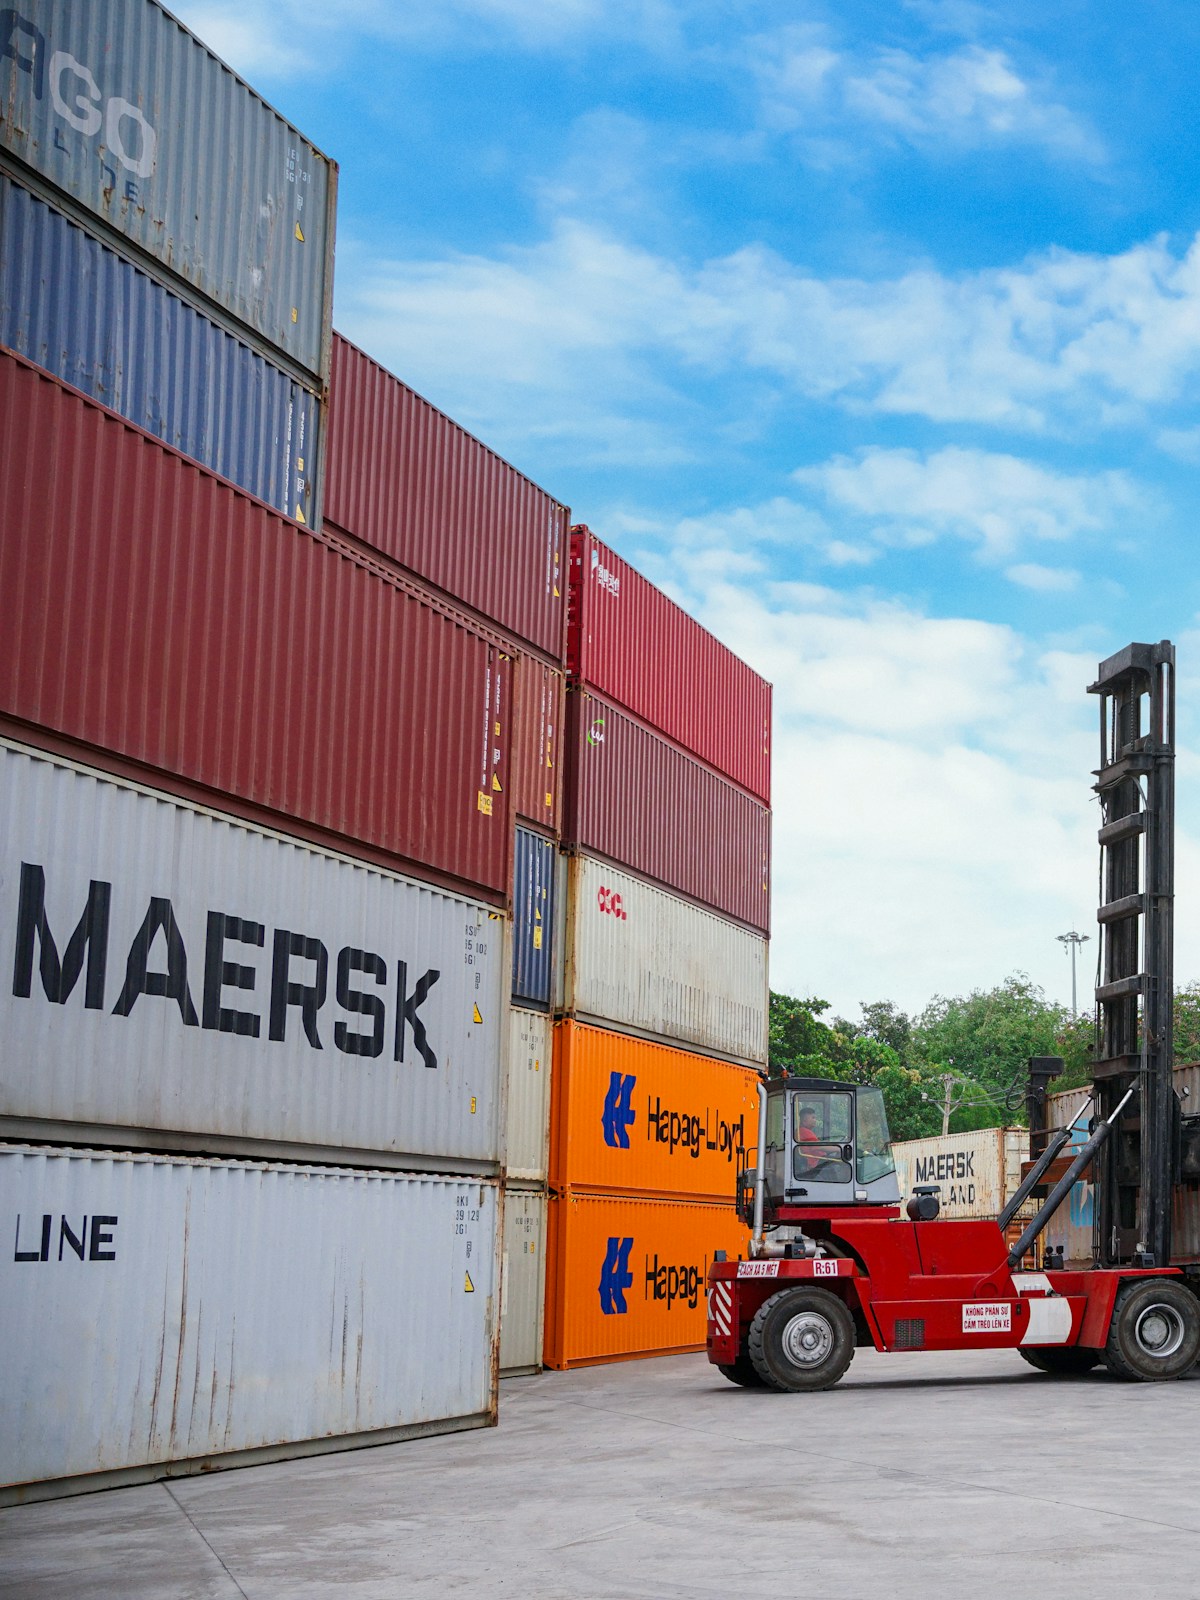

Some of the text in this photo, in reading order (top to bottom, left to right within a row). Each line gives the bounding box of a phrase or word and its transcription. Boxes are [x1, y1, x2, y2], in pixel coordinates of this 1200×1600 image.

[12, 861, 440, 1069] MAERSK
[648, 1095, 744, 1163] Hapag-Lloyd
[916, 1150, 975, 1183] MAERSK
[936, 1183, 976, 1206] LAND
[14, 1213, 118, 1262] LINE
[816, 1262, 836, 1275] R:61
[1003, 1319, 1010, 1329] XE
